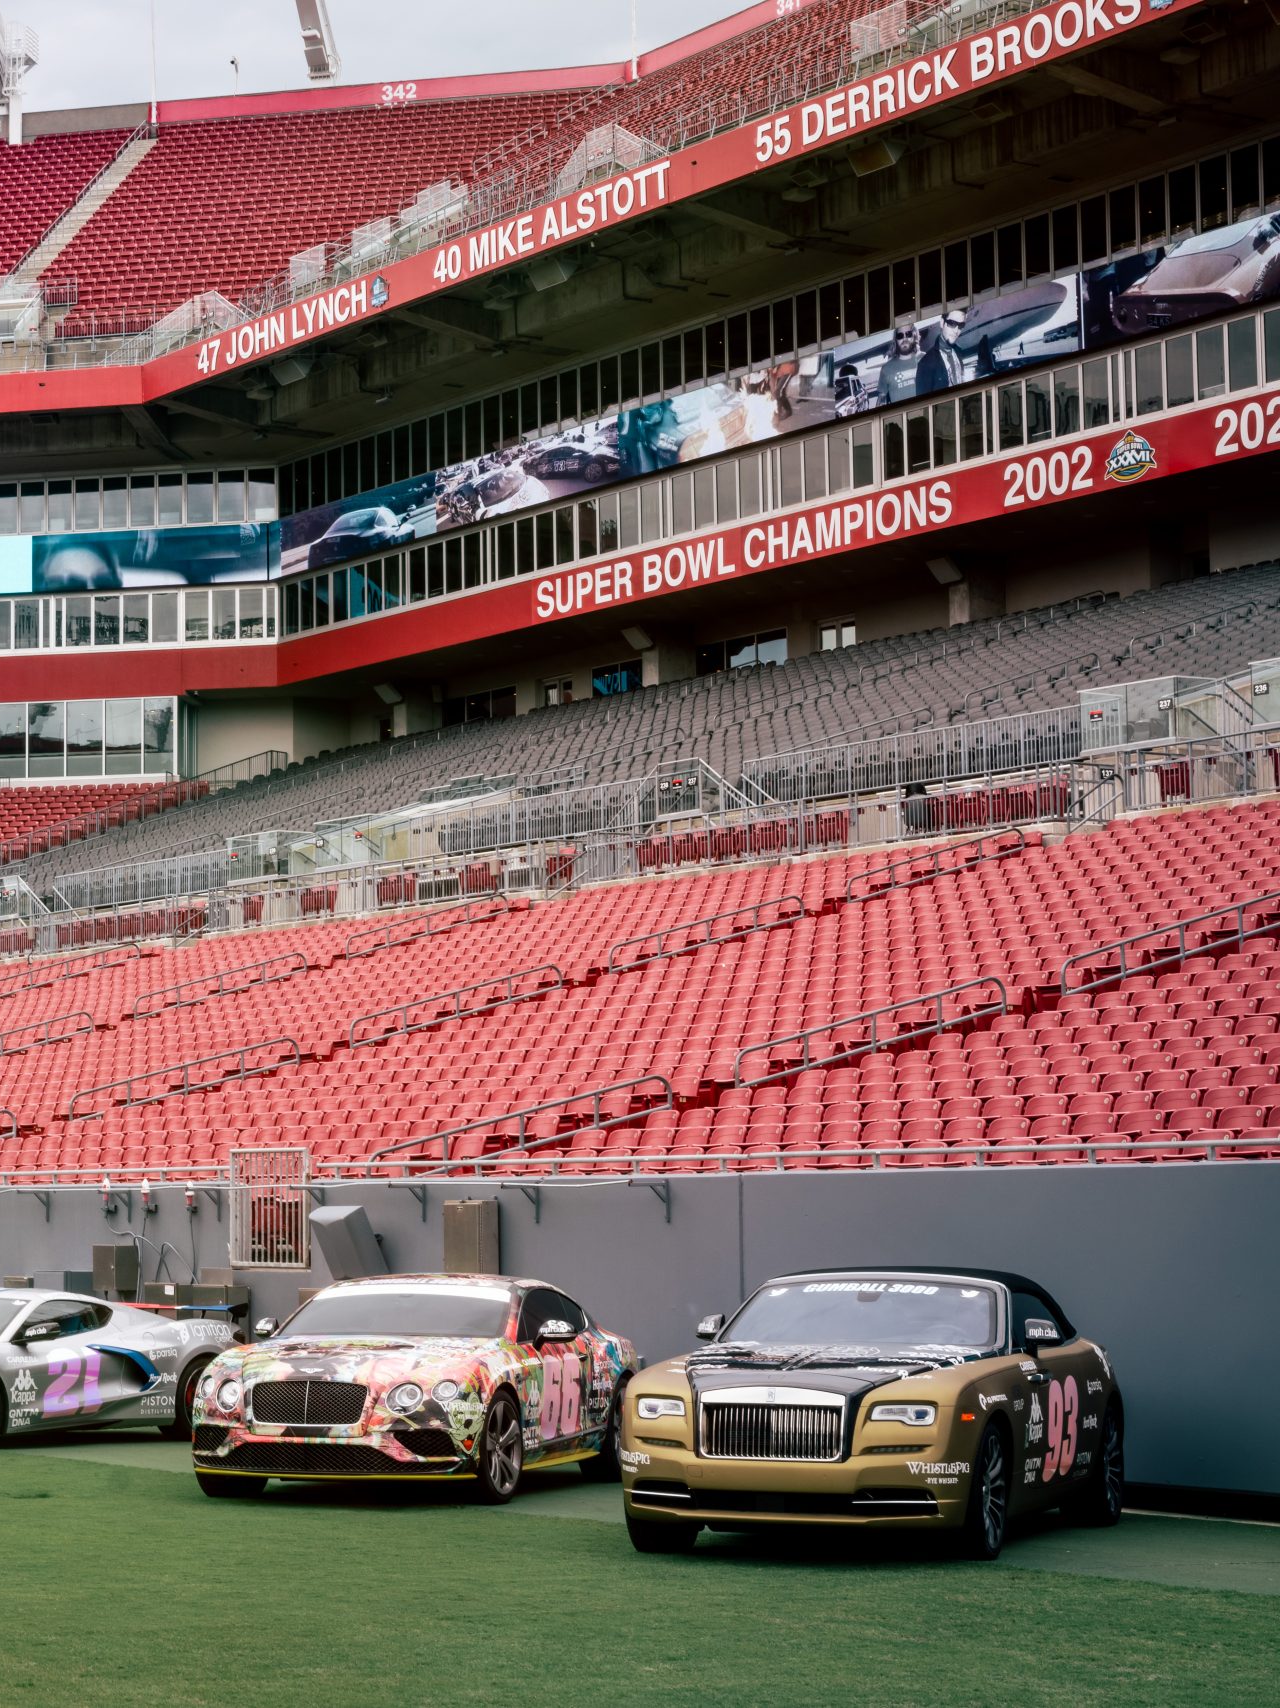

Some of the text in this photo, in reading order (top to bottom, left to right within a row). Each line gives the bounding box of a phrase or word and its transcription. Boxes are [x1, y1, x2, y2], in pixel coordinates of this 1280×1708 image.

[756, 0, 1141, 163] 55 DERRICK BROOKS
[381, 83, 417, 100] 342
[433, 160, 671, 282] 40 MIKE ALSTOTT
[197, 280, 367, 374] 47 JOHN LYNCH
[1004, 446, 1093, 507] 2002
[536, 480, 953, 618] SUPER BOWL CHAMPIONS
[1254, 684, 1267, 692] 236
[1159, 700, 1171, 708] 237
[803, 1282, 939, 1295] GUMBALL 3000
[190, 1323, 231, 1340] Ignition
[1029, 1327, 1058, 1338] mph club
[41, 1346, 101, 1419] 21
[11, 1391, 36, 1404] Kappa
[141, 1396, 175, 1406] PISTON
[541, 1352, 581, 1440] 66
[12, 1418, 31, 1427] DNA
[1042, 1375, 1079, 1483] 93
[1029, 1423, 1043, 1443] Kappa
[1024, 1457, 1042, 1471] QNTM
[1024, 1471, 1036, 1484] DNA
